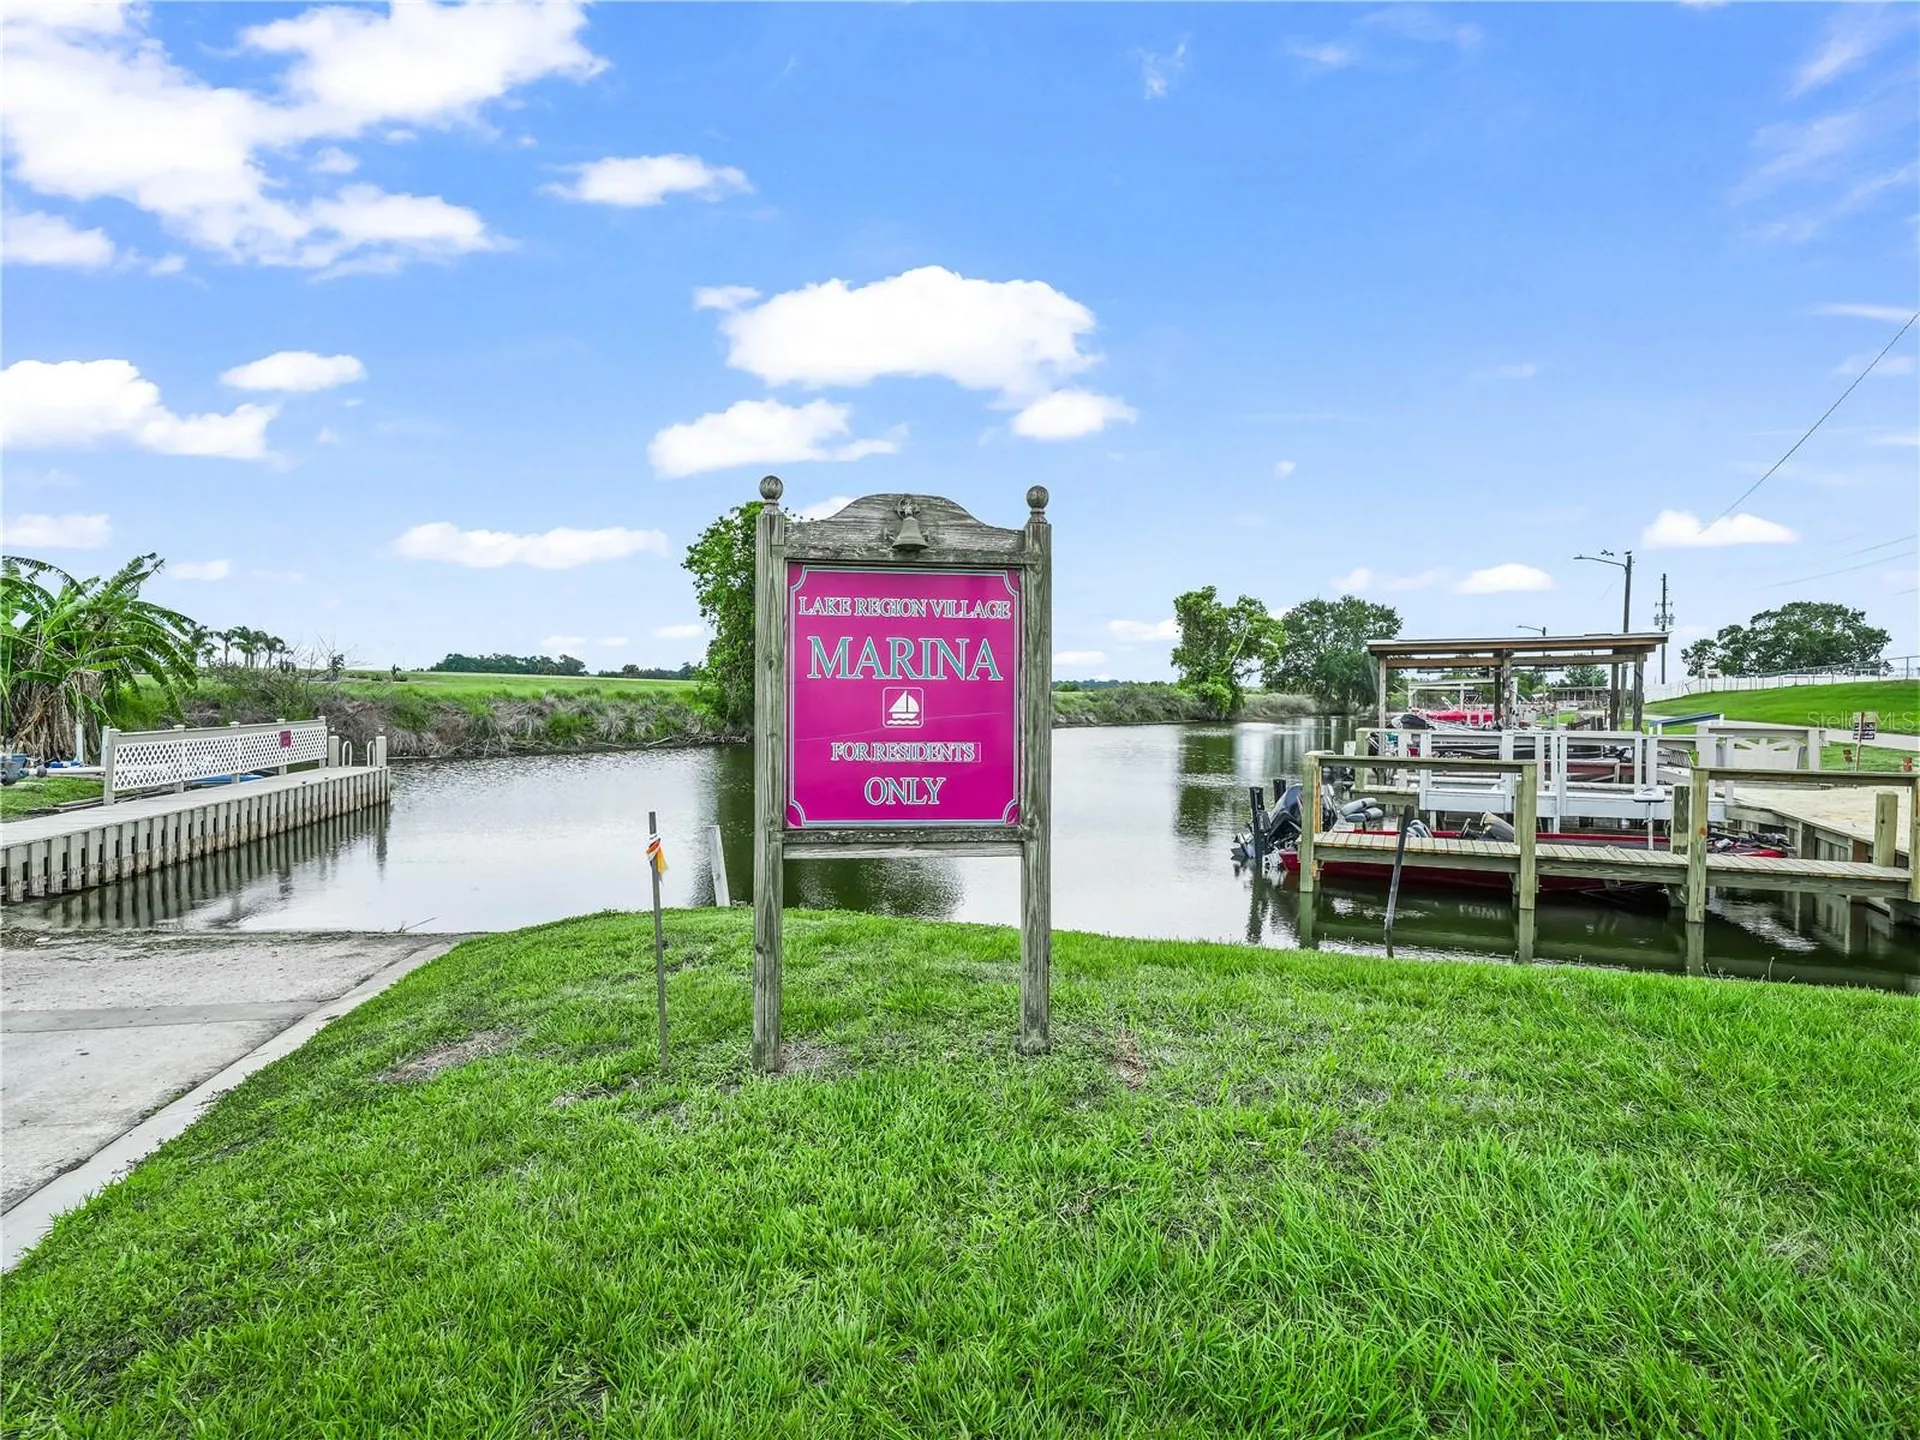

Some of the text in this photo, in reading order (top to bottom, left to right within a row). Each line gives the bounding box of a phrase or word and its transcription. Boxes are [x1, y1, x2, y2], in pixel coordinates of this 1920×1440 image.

[798, 596, 1011, 619] LAKE REGION VILLAGE
[807, 636, 1004, 681] MARINA
[830, 742, 976, 762] FOR RESIDENTS
[864, 777, 946, 805] ONLY
